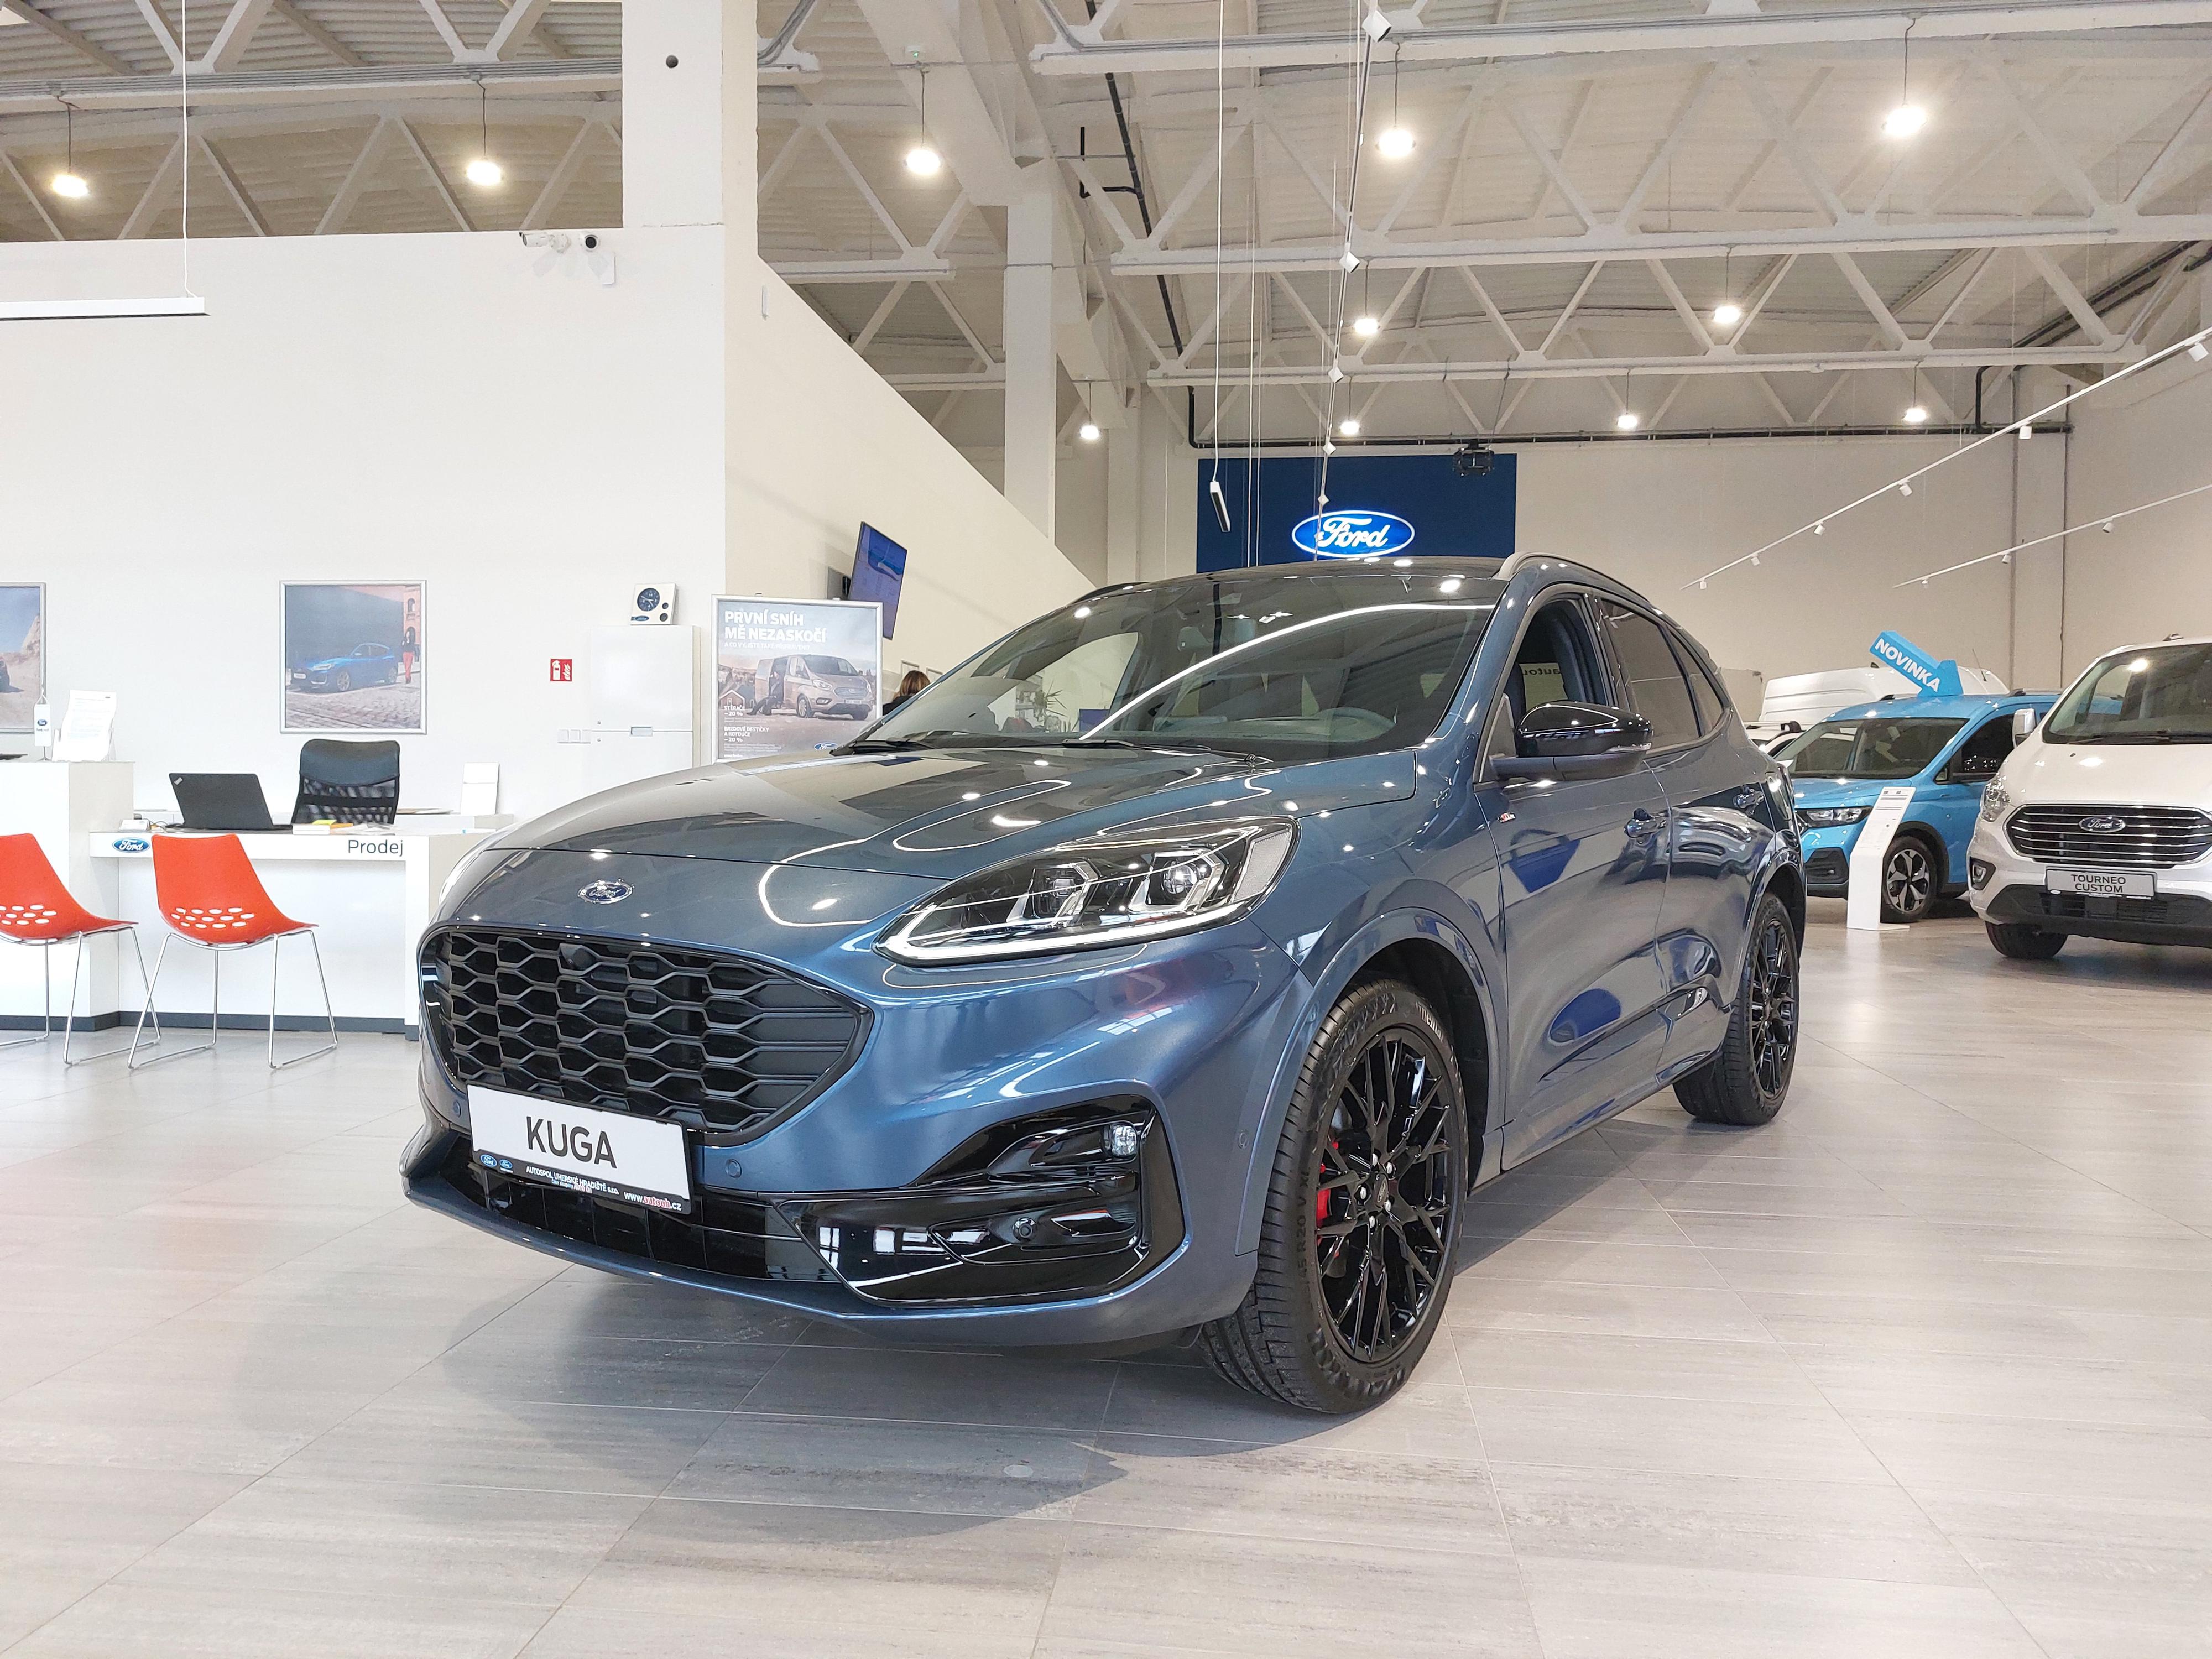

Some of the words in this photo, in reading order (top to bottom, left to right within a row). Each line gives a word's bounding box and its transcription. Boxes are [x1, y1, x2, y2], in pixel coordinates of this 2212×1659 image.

[724, 609, 769, 625] PRVNÍ
[770, 610, 804, 627] SNÍH
[724, 624, 746, 640] MĚ
[748, 627, 827, 643] NEZASKOČÍ
[1875, 638, 1940, 693] NOVINKA
[348, 839, 403, 857] Prodej
[2071, 874, 2126, 884] TOURNEO
[2075, 883, 2123, 893] CUSTOM
[526, 1116, 617, 1168] KUGA
[526, 1166, 554, 1179] AUTOSPOL
[554, 1172, 579, 1185] UHERSKÉ
[579, 1178, 607, 1192] HRADIŠTĚ
[623, 1192, 682, 1211] www.autouh.cz
